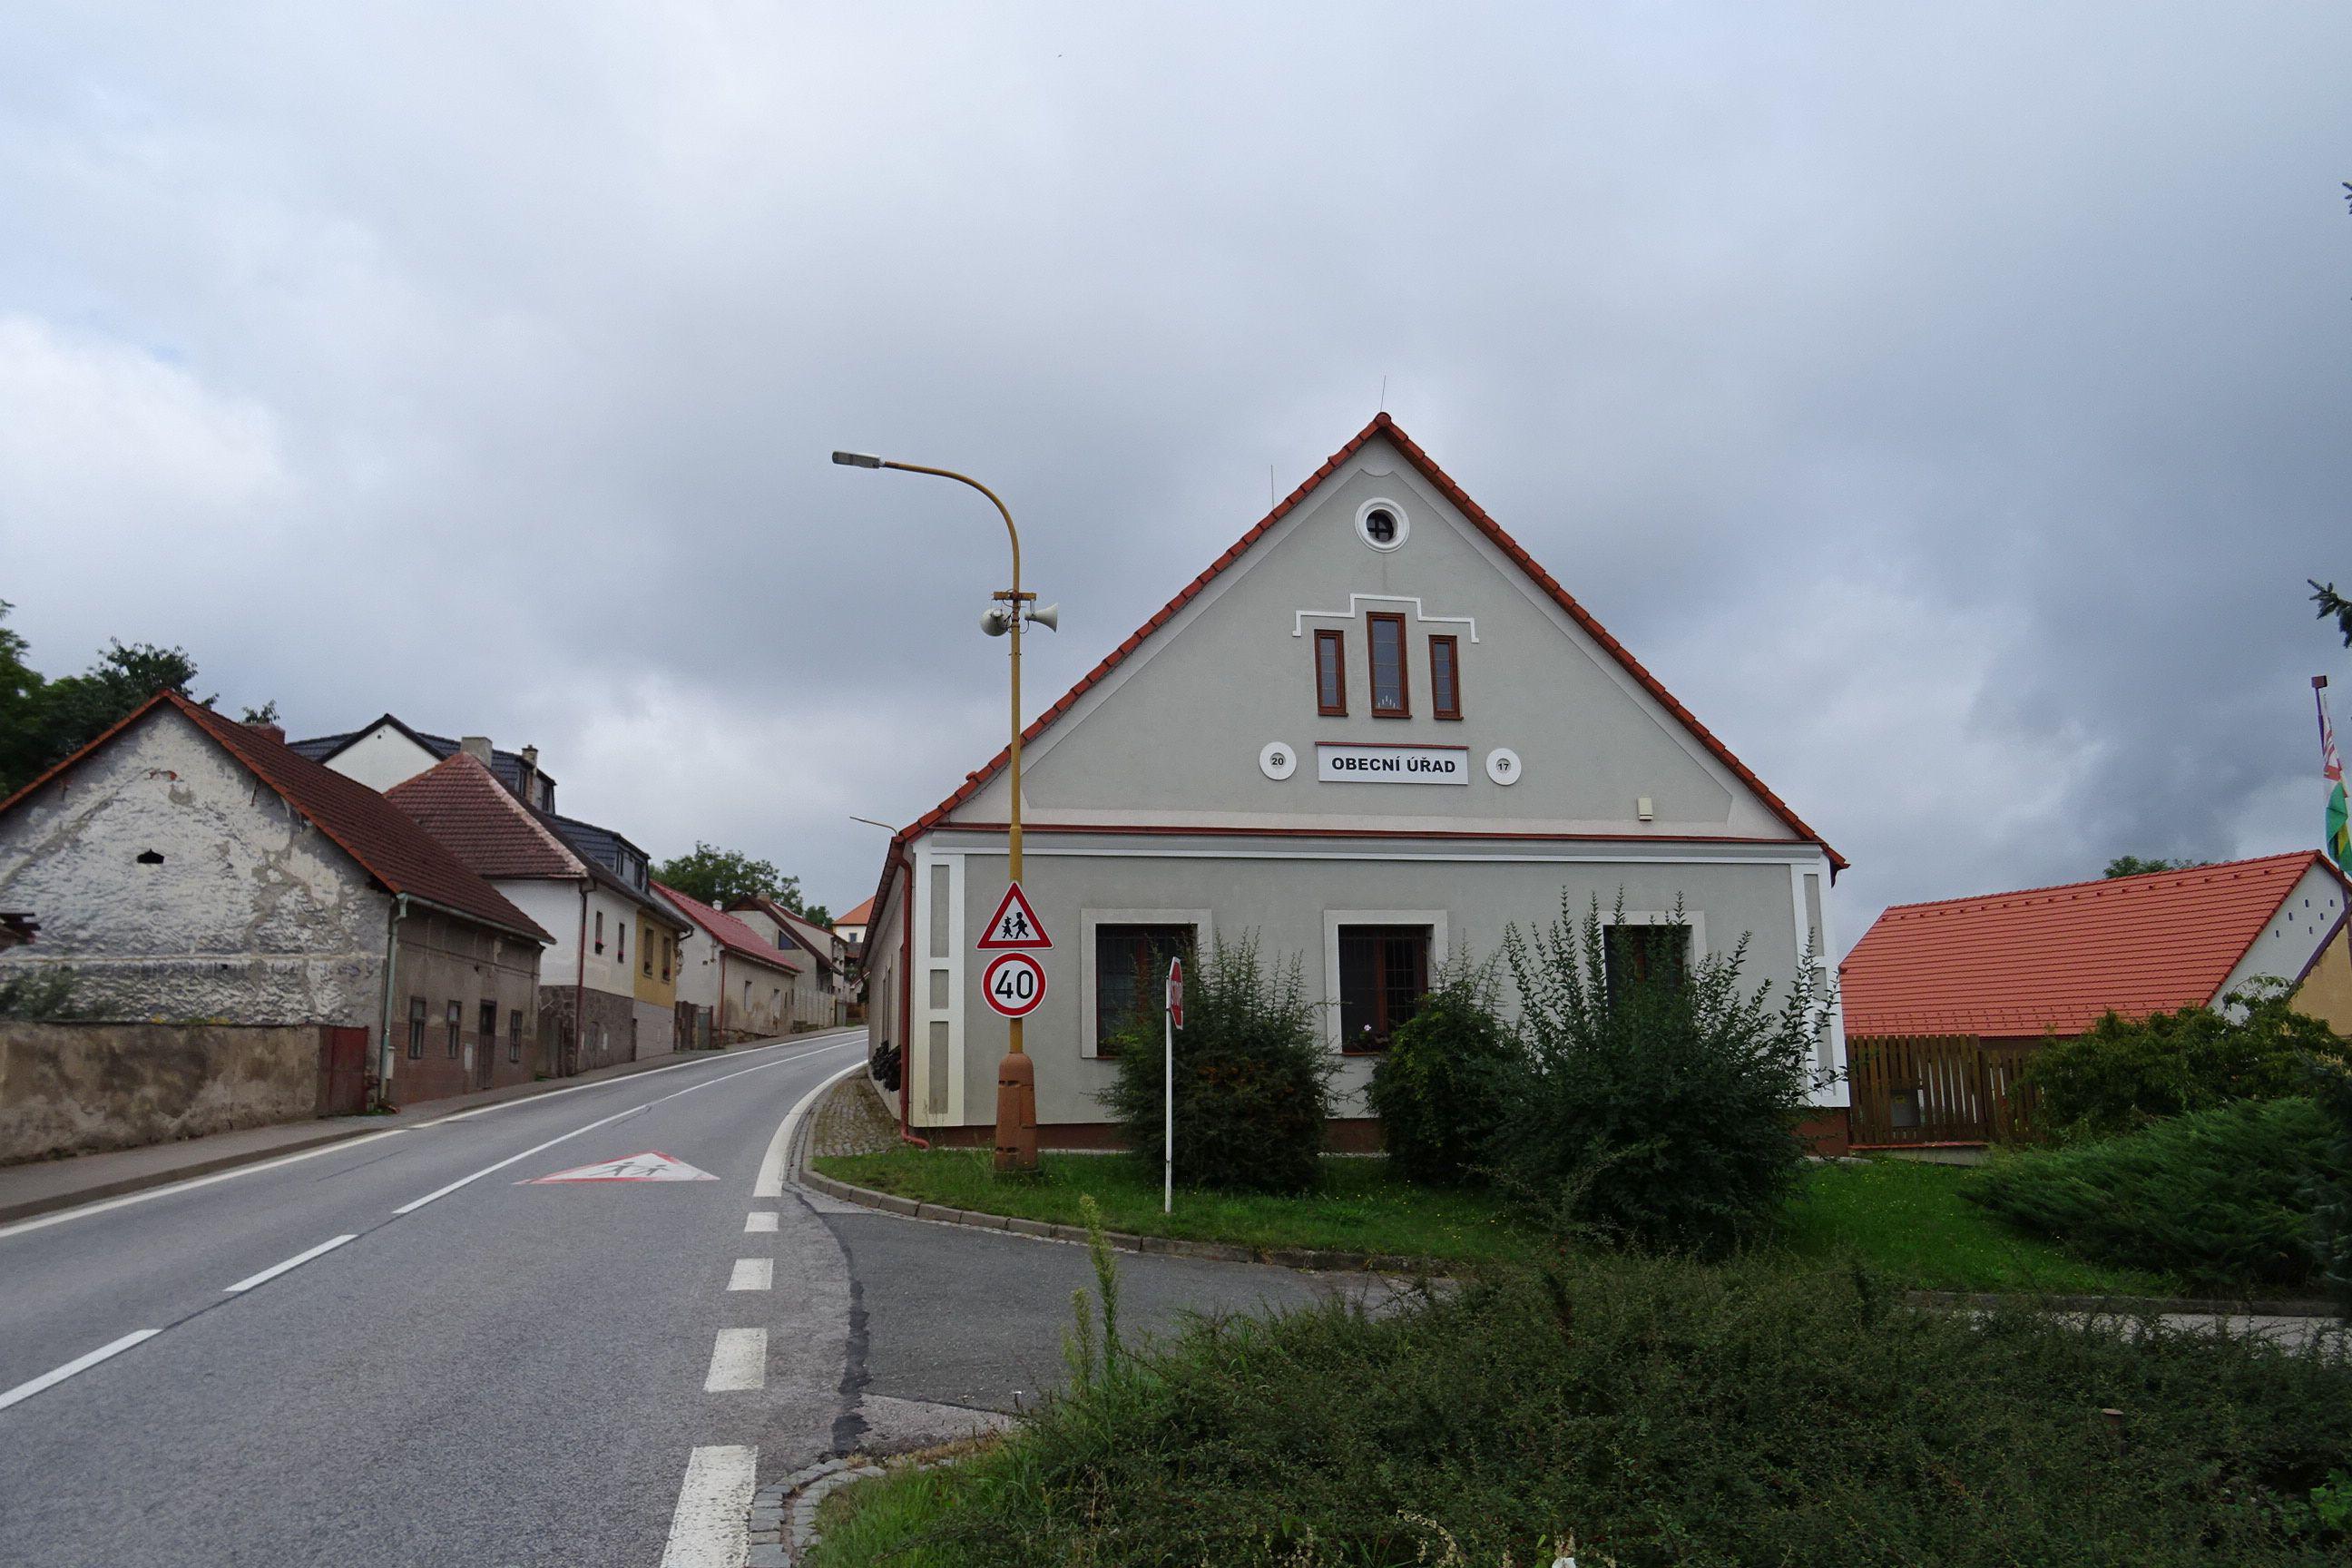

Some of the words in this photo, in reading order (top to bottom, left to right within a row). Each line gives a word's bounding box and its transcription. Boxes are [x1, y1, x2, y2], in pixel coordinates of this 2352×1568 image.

[1271, 757, 1284, 765] 20
[1331, 756, 1400, 771] OBECNÍ
[1406, 756, 1455, 772] ÚŘAD
[995, 969, 1034, 999] 40
